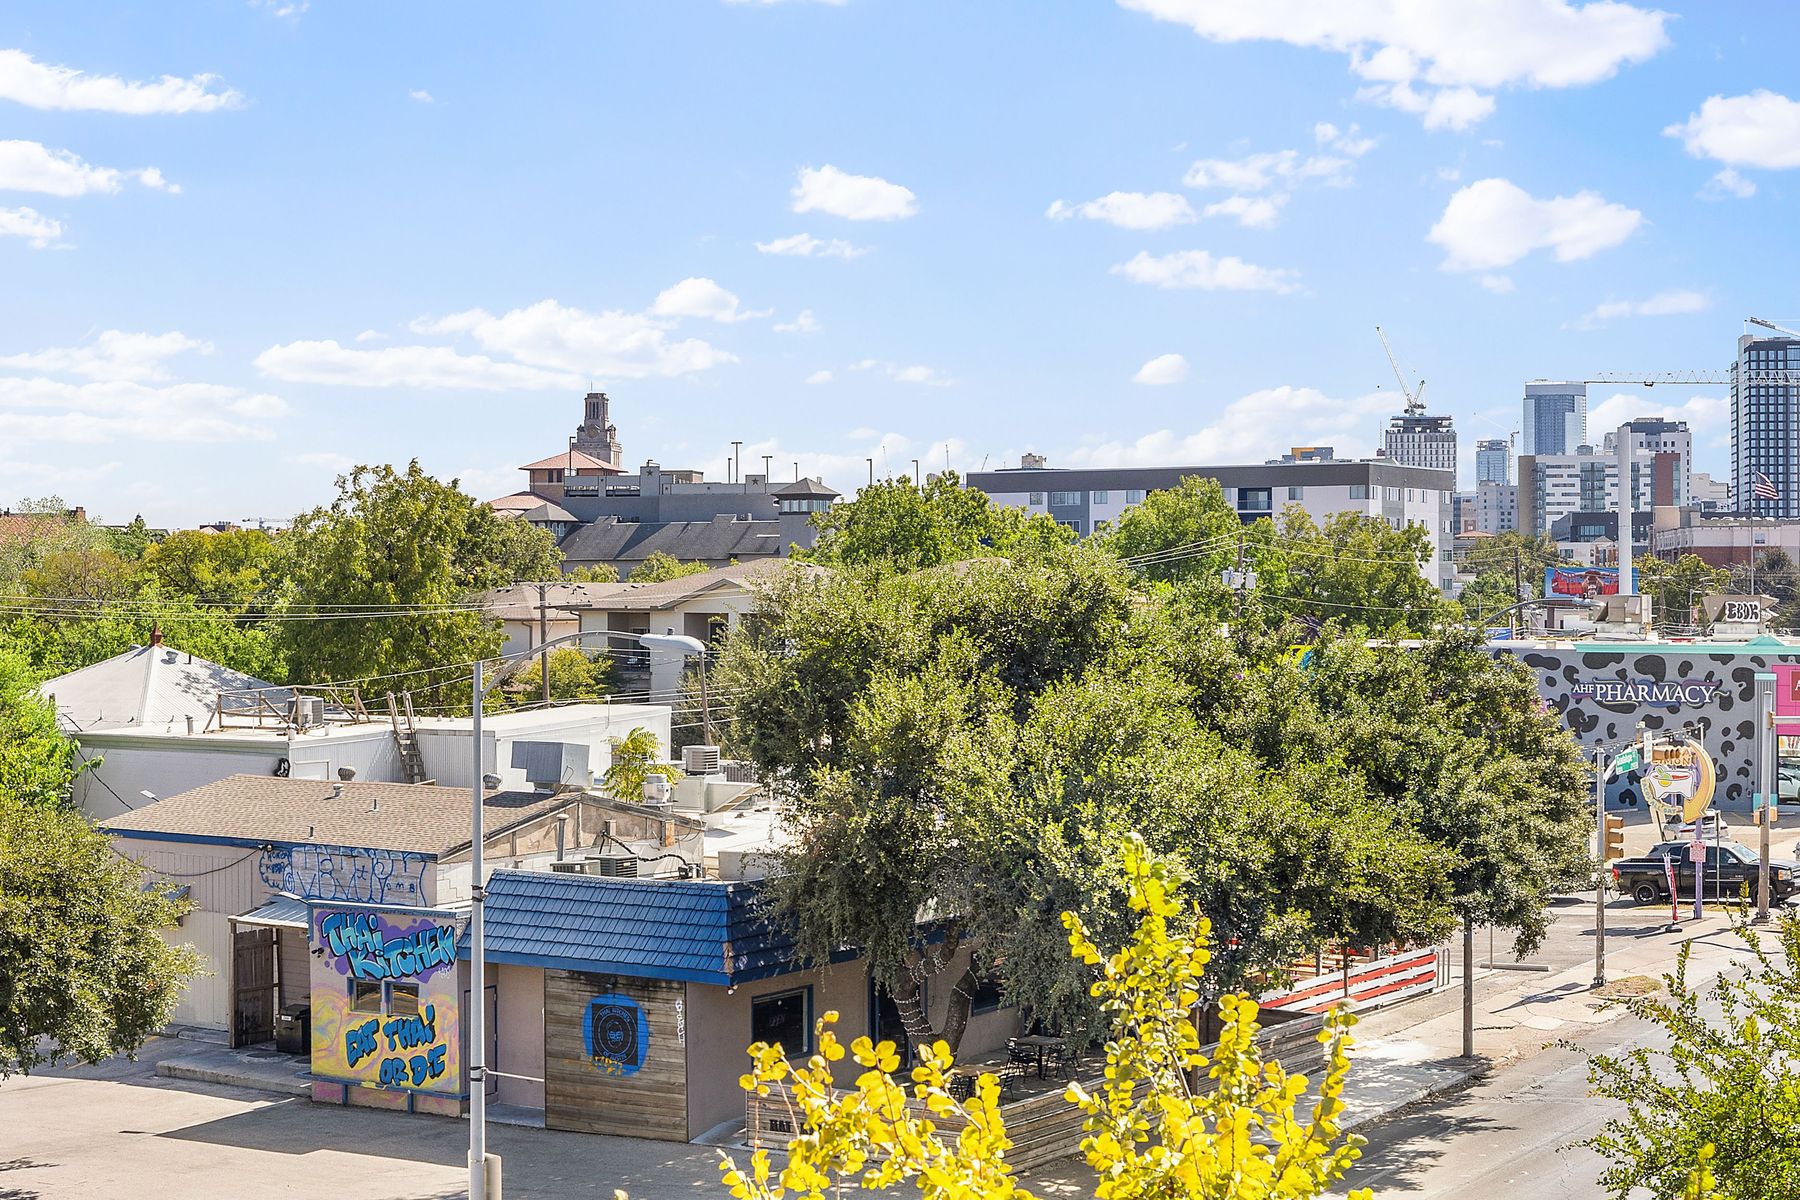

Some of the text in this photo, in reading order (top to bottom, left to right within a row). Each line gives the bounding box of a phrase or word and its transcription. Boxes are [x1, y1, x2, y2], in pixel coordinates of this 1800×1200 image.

[1573, 683, 1716, 703] AHF PHARMACY
[345, 1018, 380, 1068] EAT
[379, 1057, 410, 1087] OR
